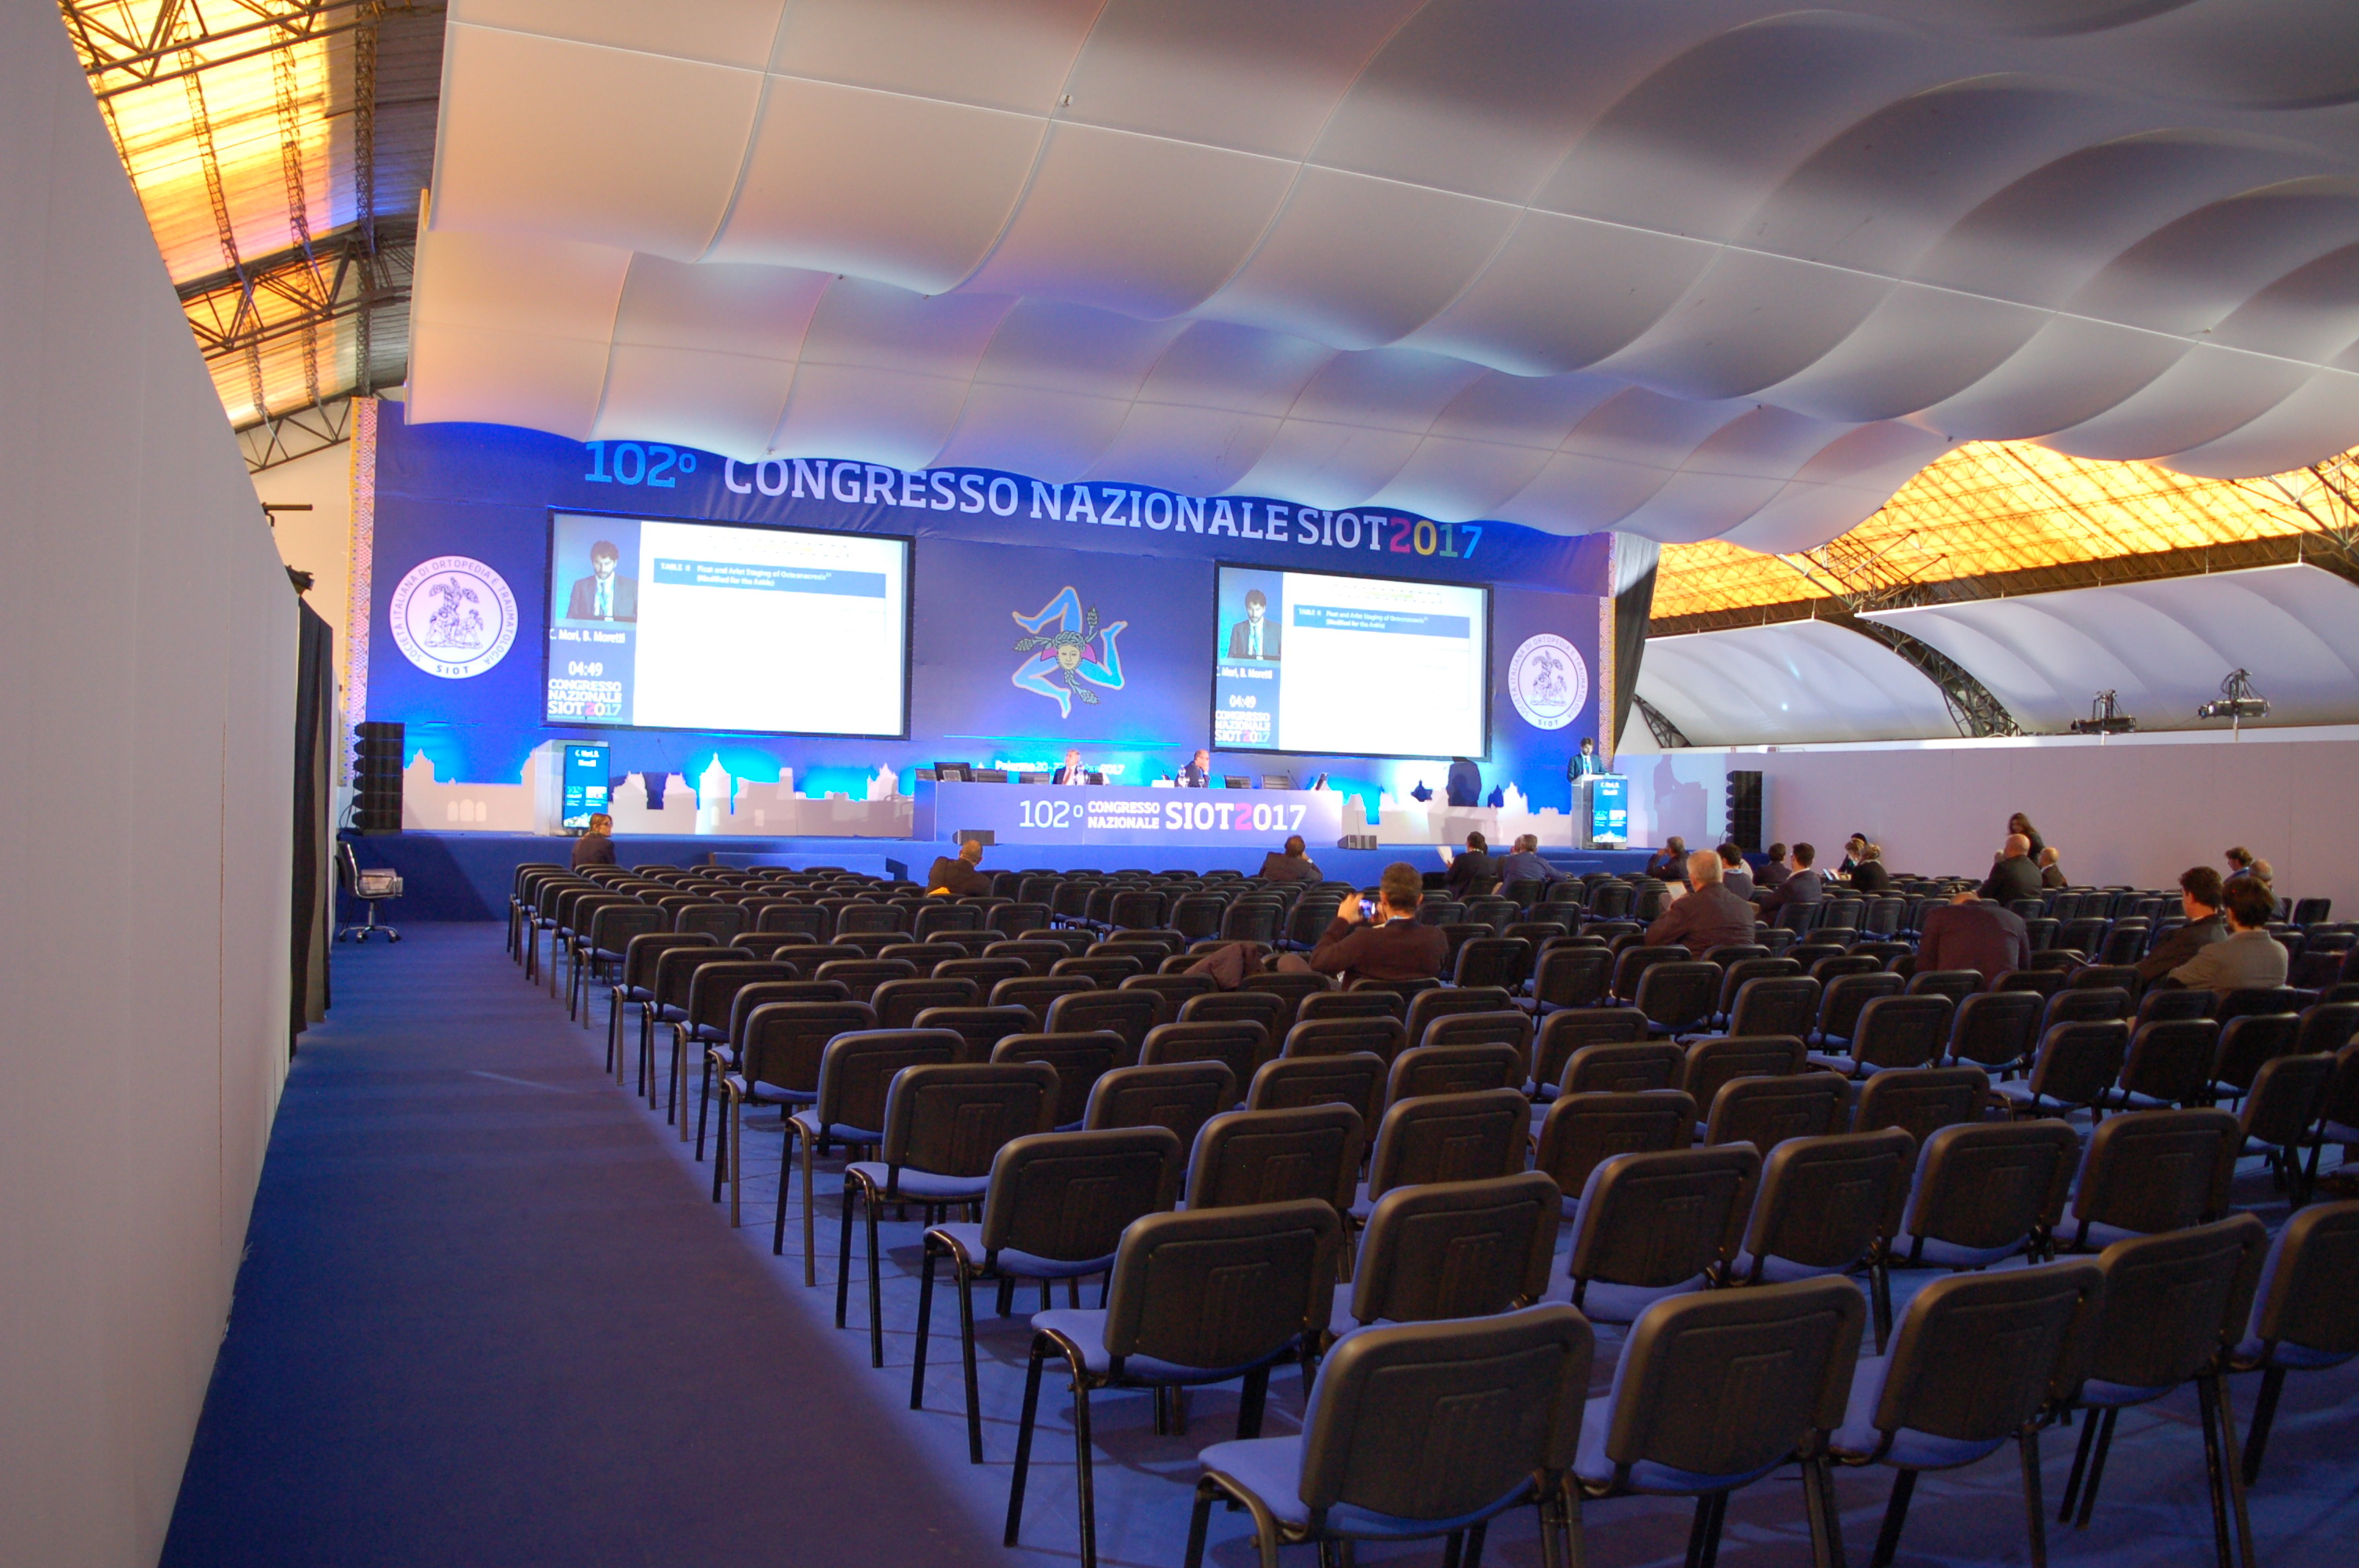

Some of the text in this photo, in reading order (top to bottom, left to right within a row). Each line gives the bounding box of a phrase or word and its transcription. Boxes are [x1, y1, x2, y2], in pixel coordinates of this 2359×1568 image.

[725, 458, 1019, 516] CONGRESSO
[1030, 481, 1288, 542] NAZIONALE
[660, 562, 683, 572] TABLE
[394, 575, 419, 619] ITALIANA
[418, 566, 430, 577] DI
[432, 559, 491, 579] ORTOPEDIA
[483, 586, 515, 665] TRAUMATOLOGIA
[436, 665, 469, 675] SIOT
[569, 661, 603, 677] 04:49
[549, 678, 622, 691] CONGRESSO
[548, 690, 623, 702] NAZIONALE
[1229, 695, 1256, 709] 04:49
[1215, 710, 1270, 721] CONGRESSO
[1215, 720, 1270, 731] NAZIONALE
[1087, 800, 1160, 815] CONGRESSO
[1087, 816, 1160, 829] NAZIONALE
